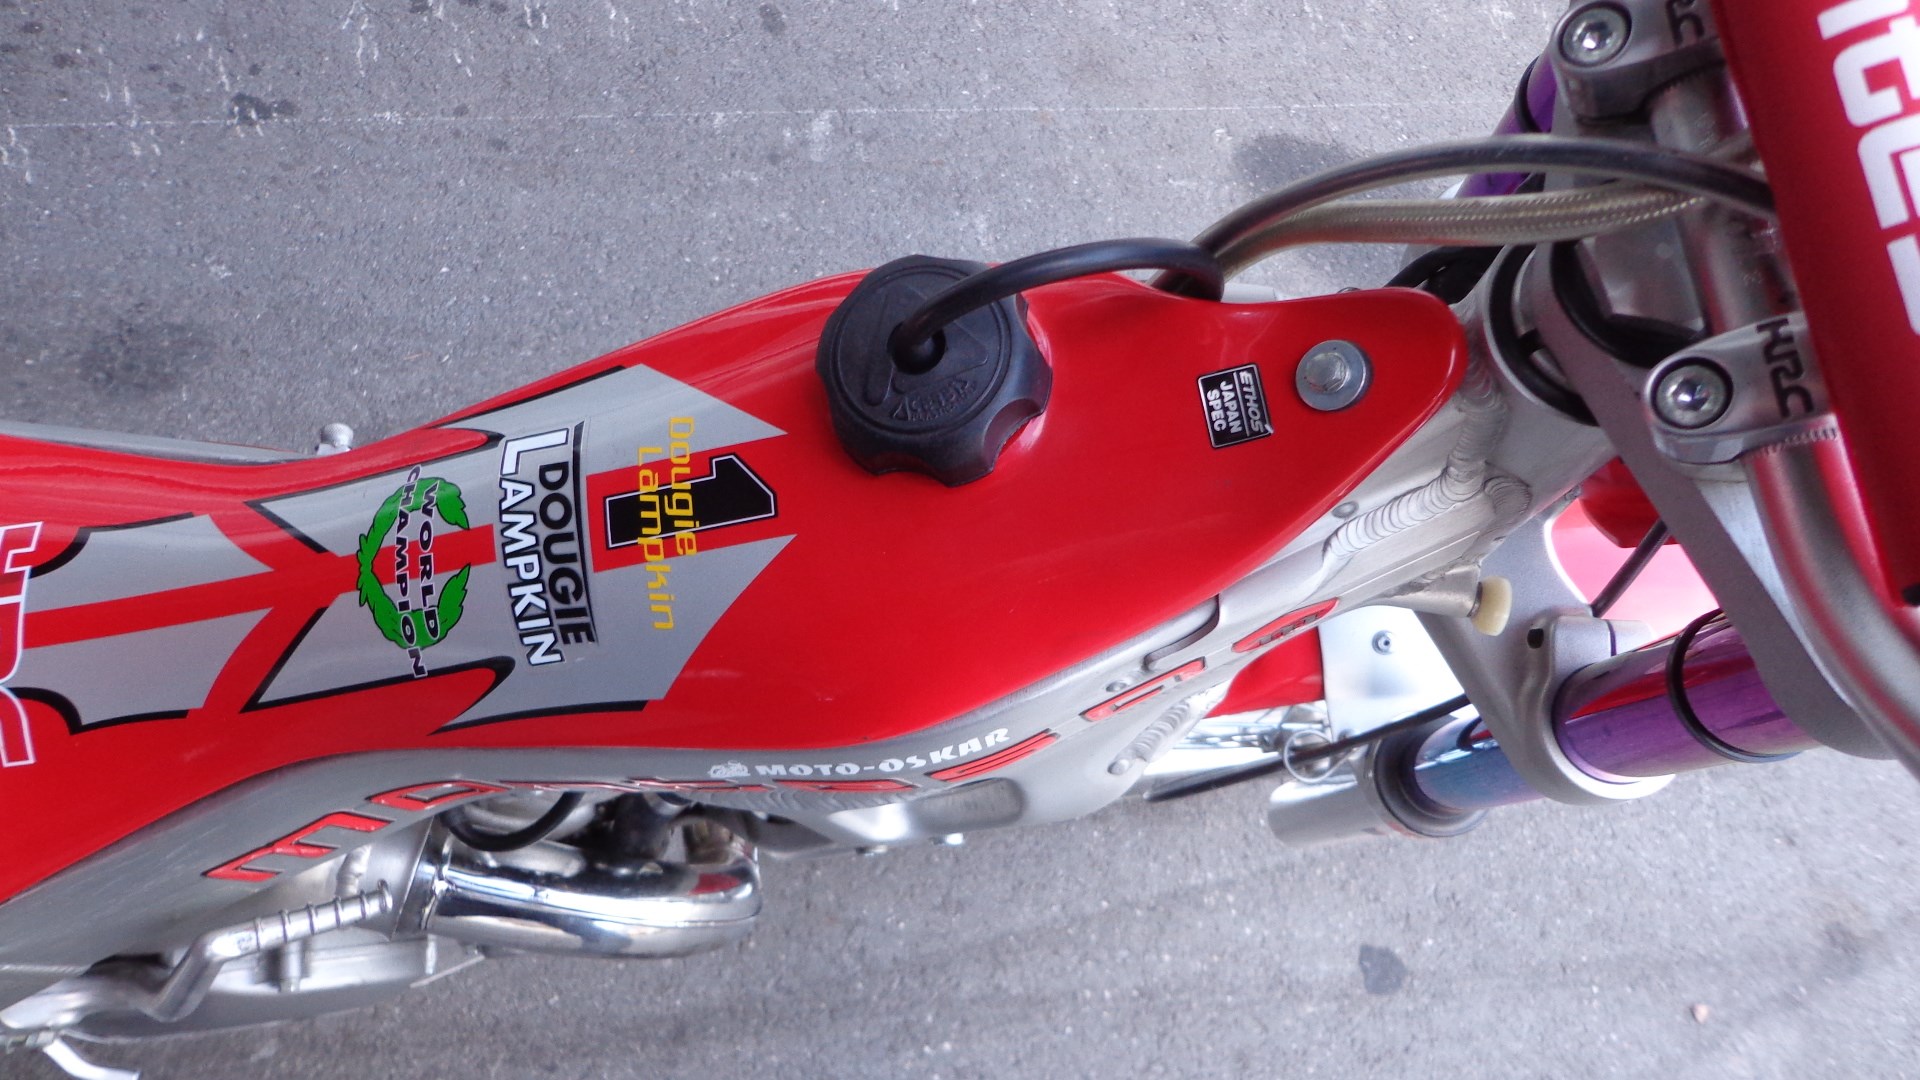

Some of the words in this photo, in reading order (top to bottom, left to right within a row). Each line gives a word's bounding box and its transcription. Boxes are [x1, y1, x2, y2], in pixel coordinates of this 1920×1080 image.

[1206, 388, 1227, 432] SPEC
[1219, 380, 1243, 434] JAPAN
[1239, 370, 1264, 433] ETHOS
[1756, 317, 1814, 418] HRC
[604, 453, 778, 550] 1
[638, 446, 674, 630] Lampkin
[666, 417, 700, 556] Dougie
[395, 464, 428, 678] CHAMPION
[419, 480, 440, 639] WORLD
[500, 428, 569, 667] LAMPKIN
[538, 461, 595, 646] DOUGIE
[755, 727, 1011, 778] MOTO-OSKAR
